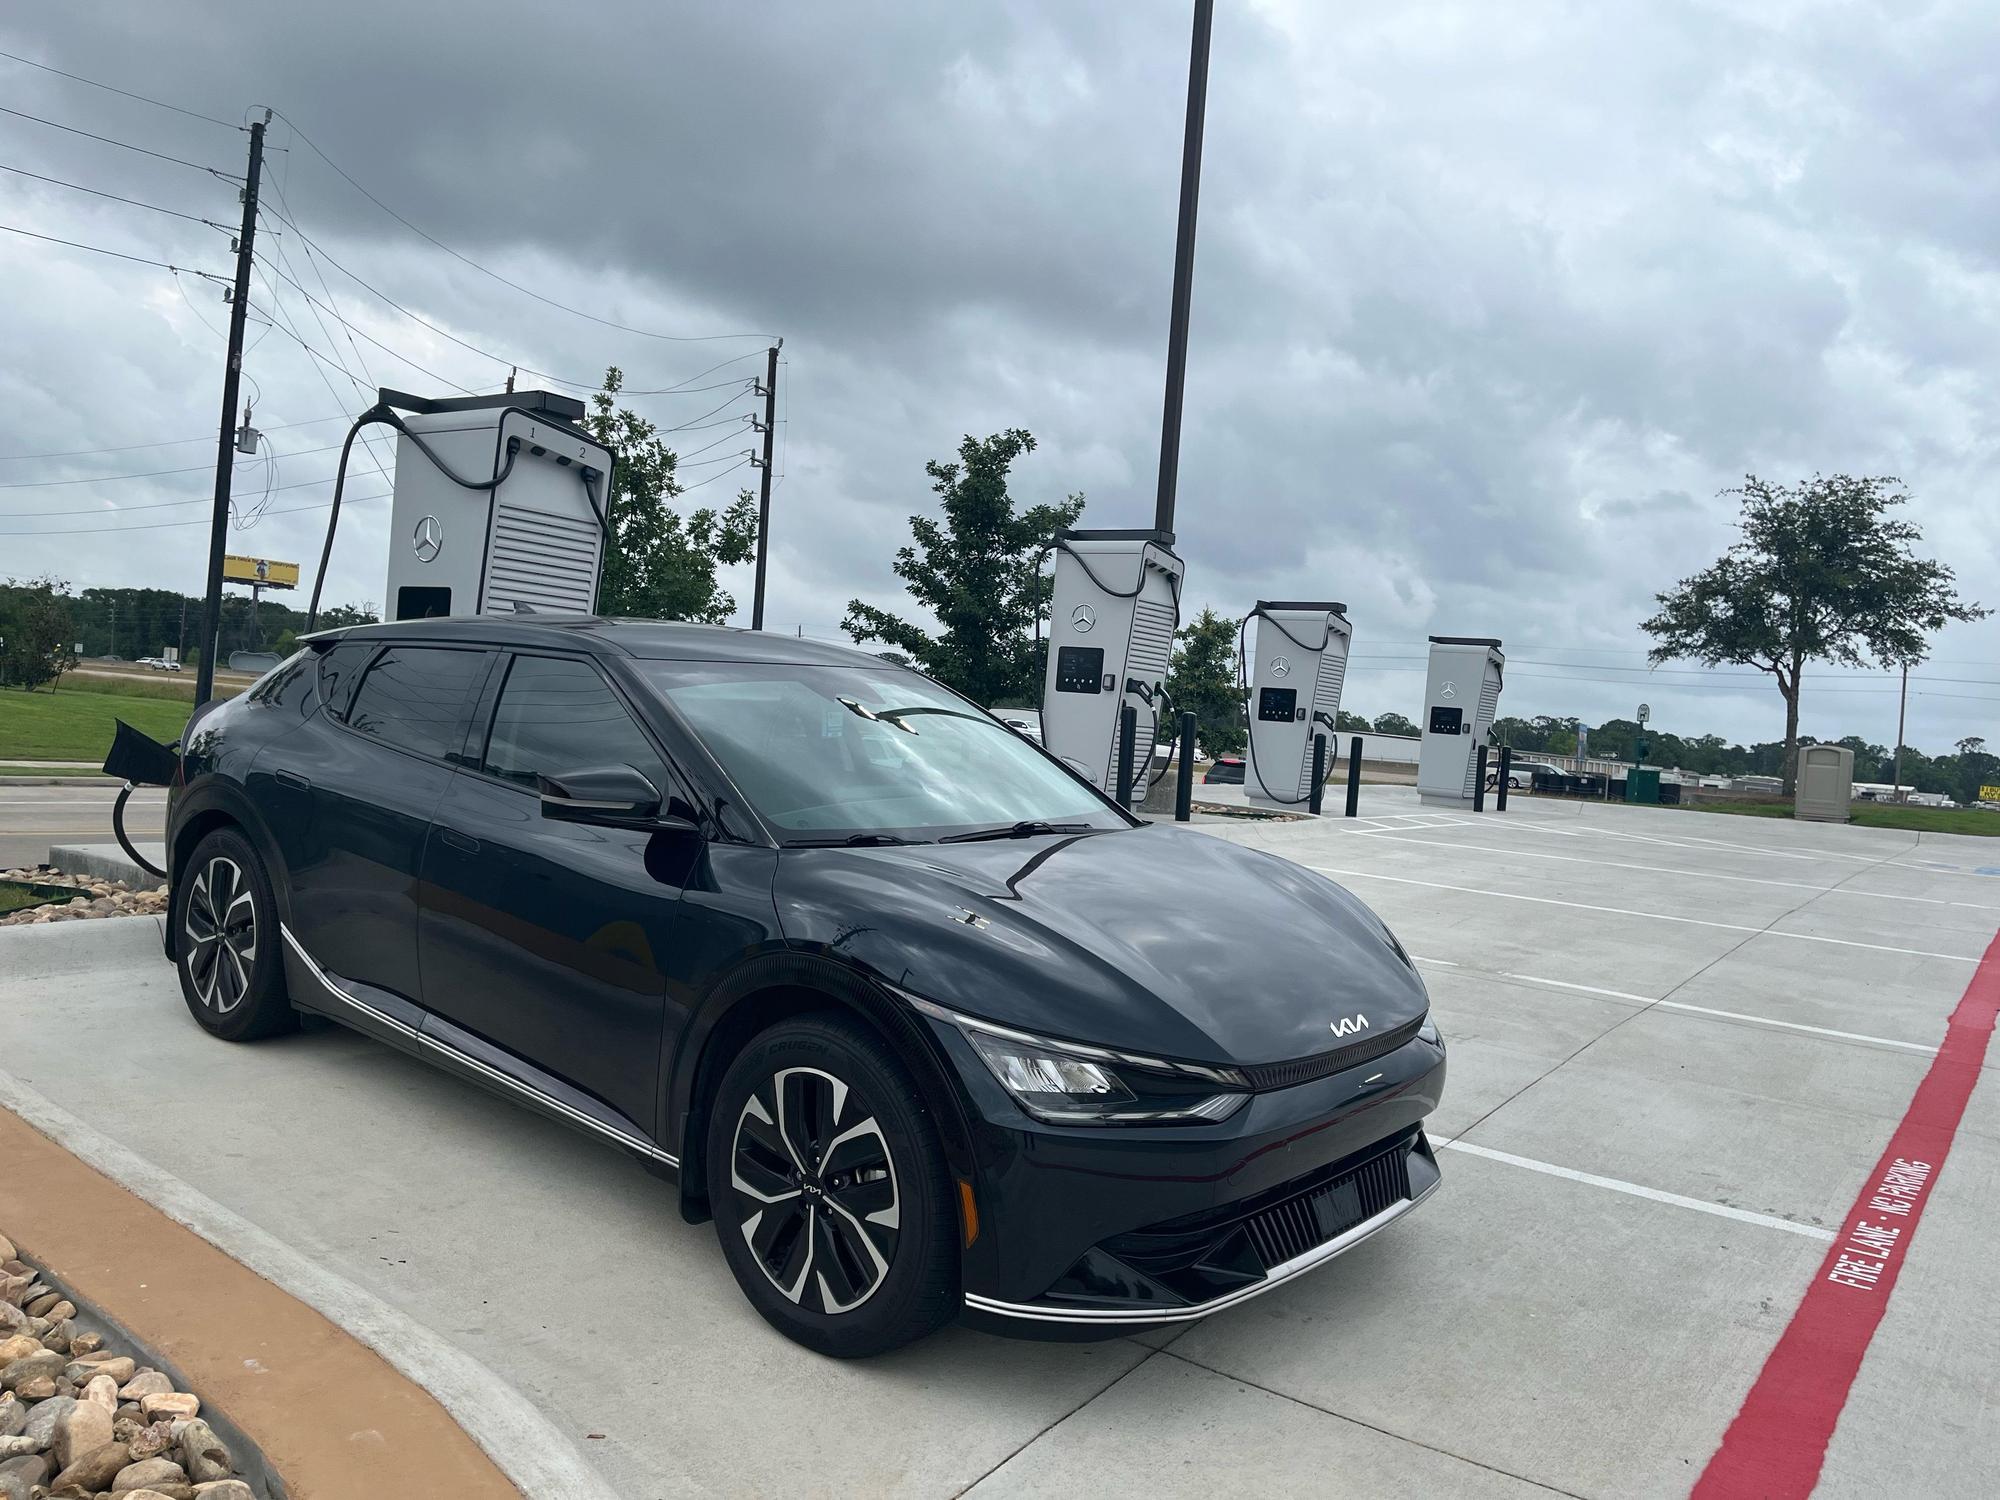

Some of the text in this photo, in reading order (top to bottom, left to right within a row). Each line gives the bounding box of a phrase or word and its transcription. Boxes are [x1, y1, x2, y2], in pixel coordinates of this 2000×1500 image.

[530, 427, 535, 438] 1
[579, 447, 586, 458] 2
[1330, 1013, 1369, 1038] KIA
[1877, 1158, 1932, 1201] PARKING
[1868, 1195, 1913, 1217] NO
[1844, 1221, 1901, 1260] LANE
[1828, 1253, 1885, 1291] FIRE
